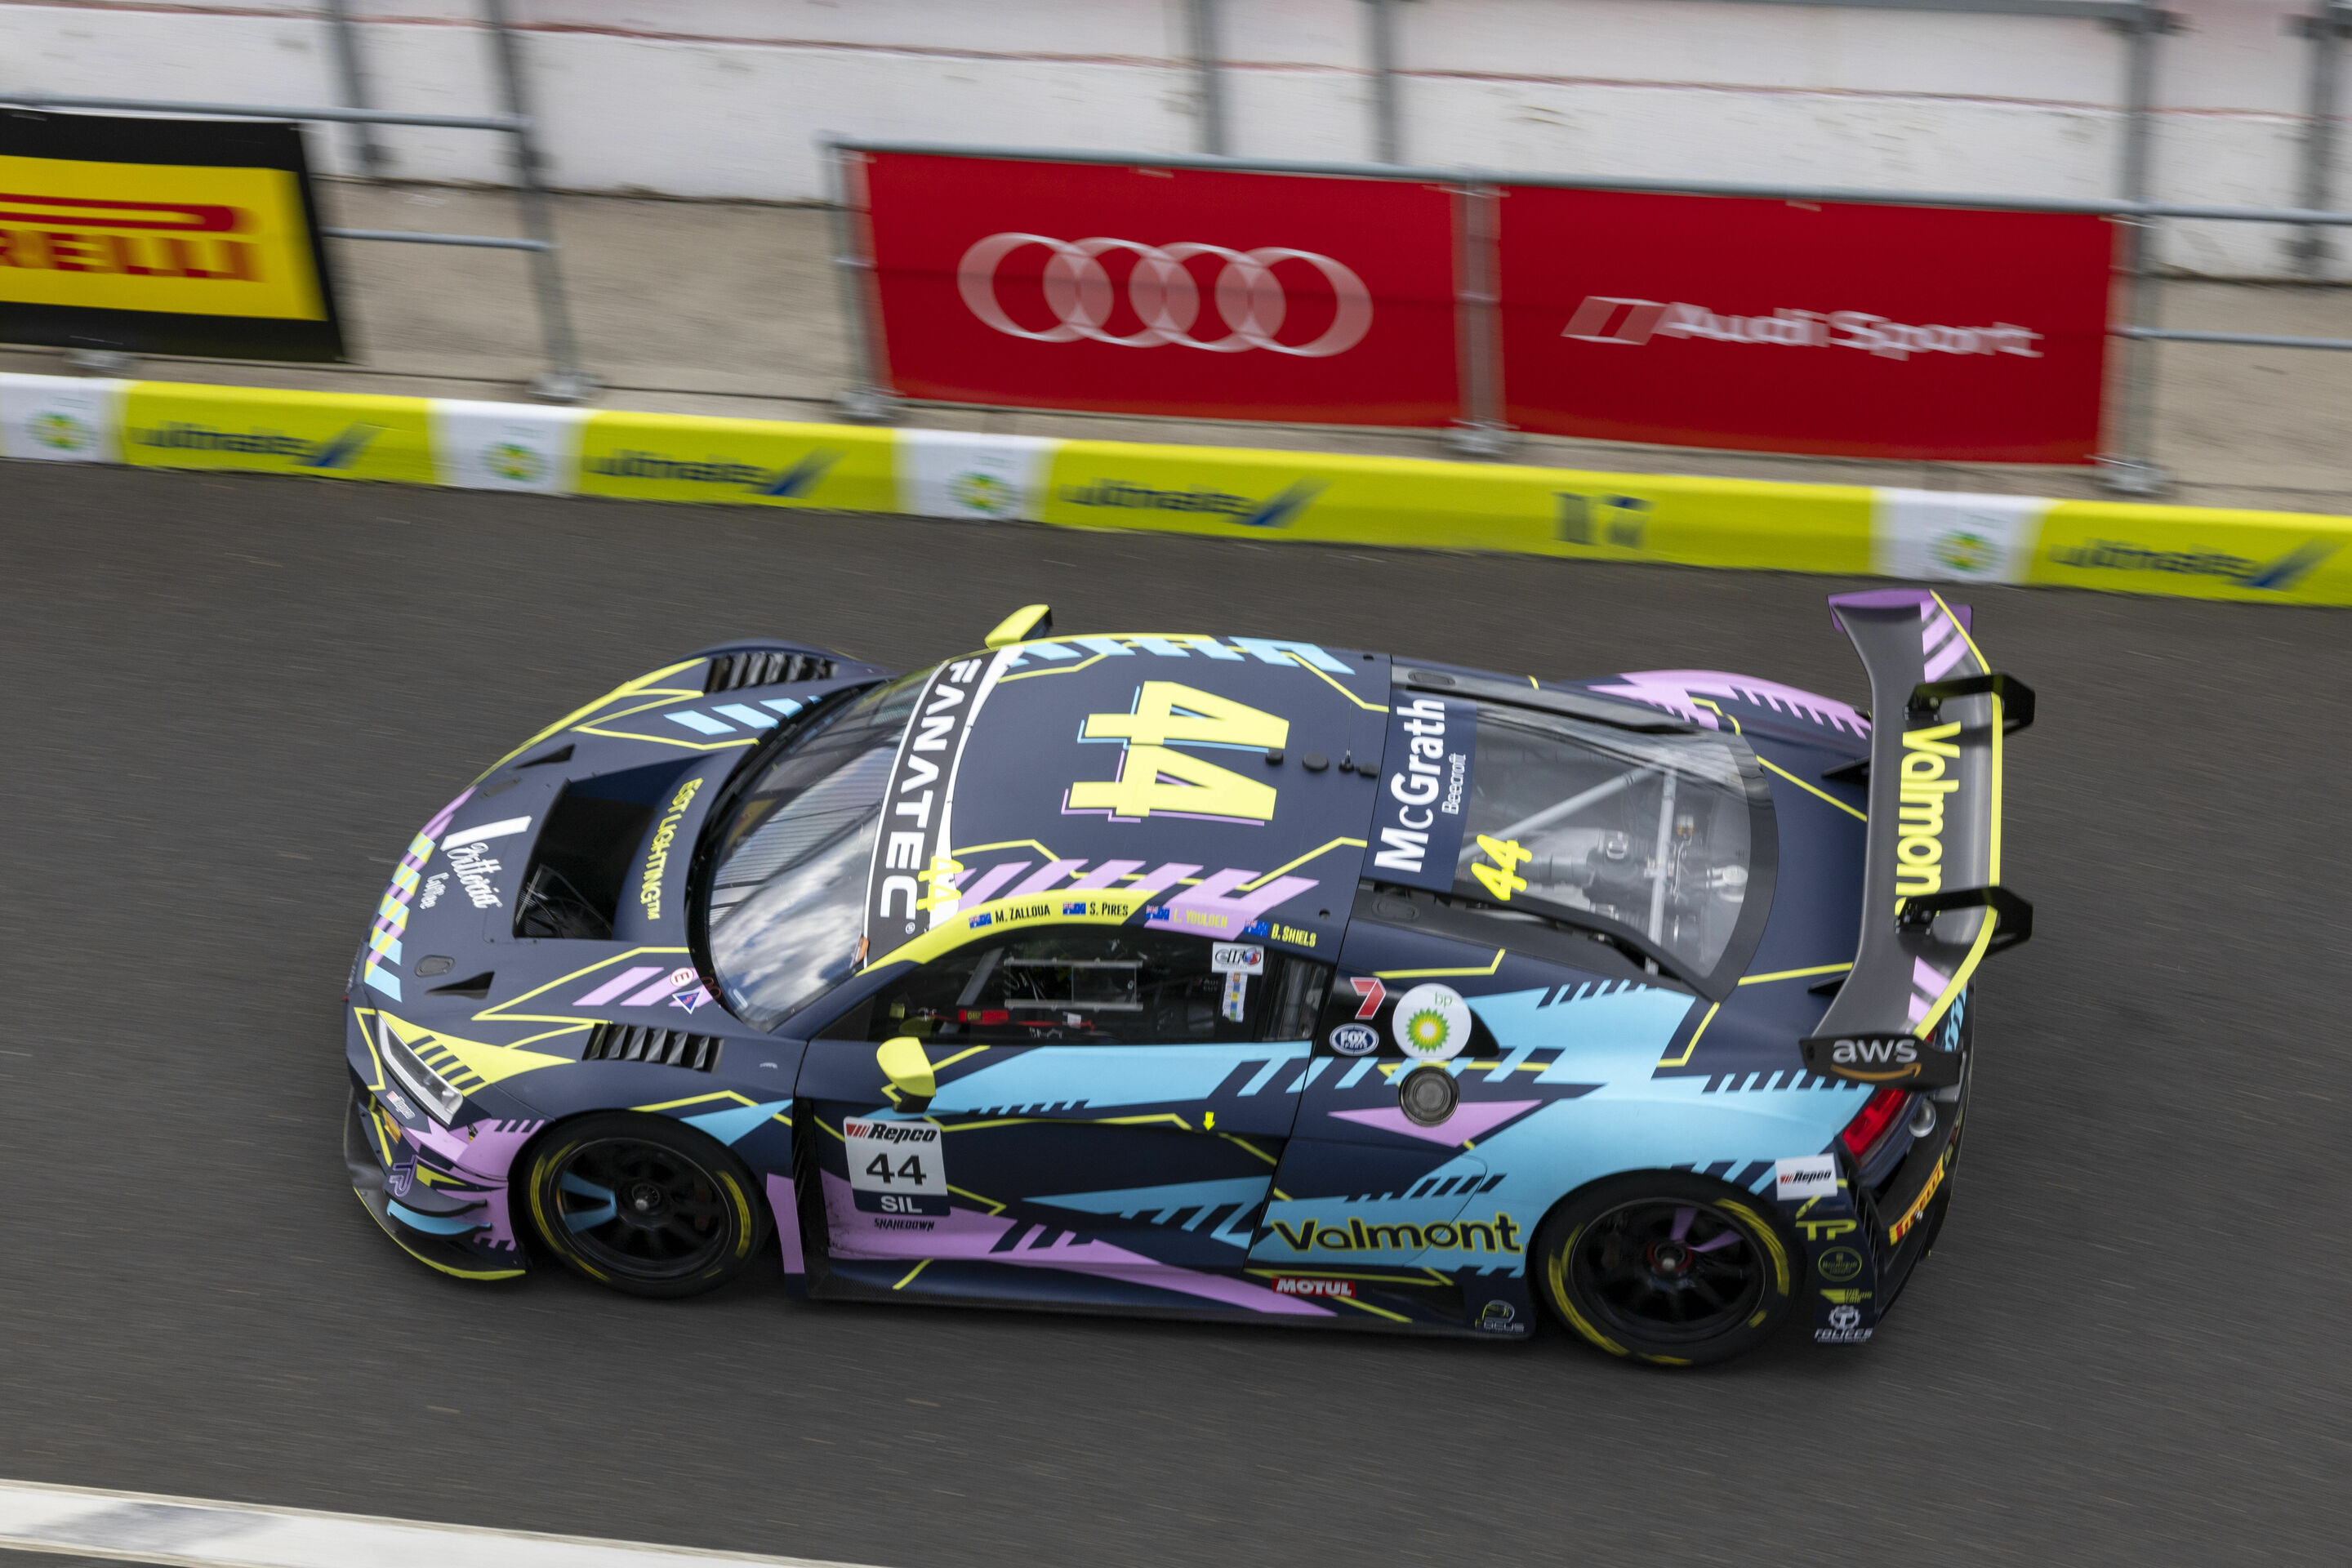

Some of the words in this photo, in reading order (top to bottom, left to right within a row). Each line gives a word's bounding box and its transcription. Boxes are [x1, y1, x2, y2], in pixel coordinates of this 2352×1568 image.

[1655, 301, 1830, 347] Audi
[1828, 310, 2044, 361] Sport
[1063, 681, 1290, 823] 44
[1374, 699, 1446, 874] McGrath
[1441, 753, 1467, 815] Beecroft
[1895, 720, 1962, 916] Valmon
[1471, 835, 1532, 901] 44
[916, 856, 964, 912] 44
[995, 910, 1008, 924] M.
[1010, 904, 1050, 922] ZALLOUA
[1089, 902, 1099, 915] S.
[1102, 902, 1129, 917] PIRES
[1281, 925, 1316, 948] SHIELS
[1435, 991, 1453, 1008] bp
[1833, 1039, 1918, 1063] aws
[867, 1122, 938, 1144] Repco
[866, 1152, 927, 1186] 44
[1793, 1169, 1832, 1185] Repco
[880, 1195, 923, 1214] SIL
[1270, 1212, 1524, 1254] Valmont
[1276, 1278, 1352, 1296] MOTUL
